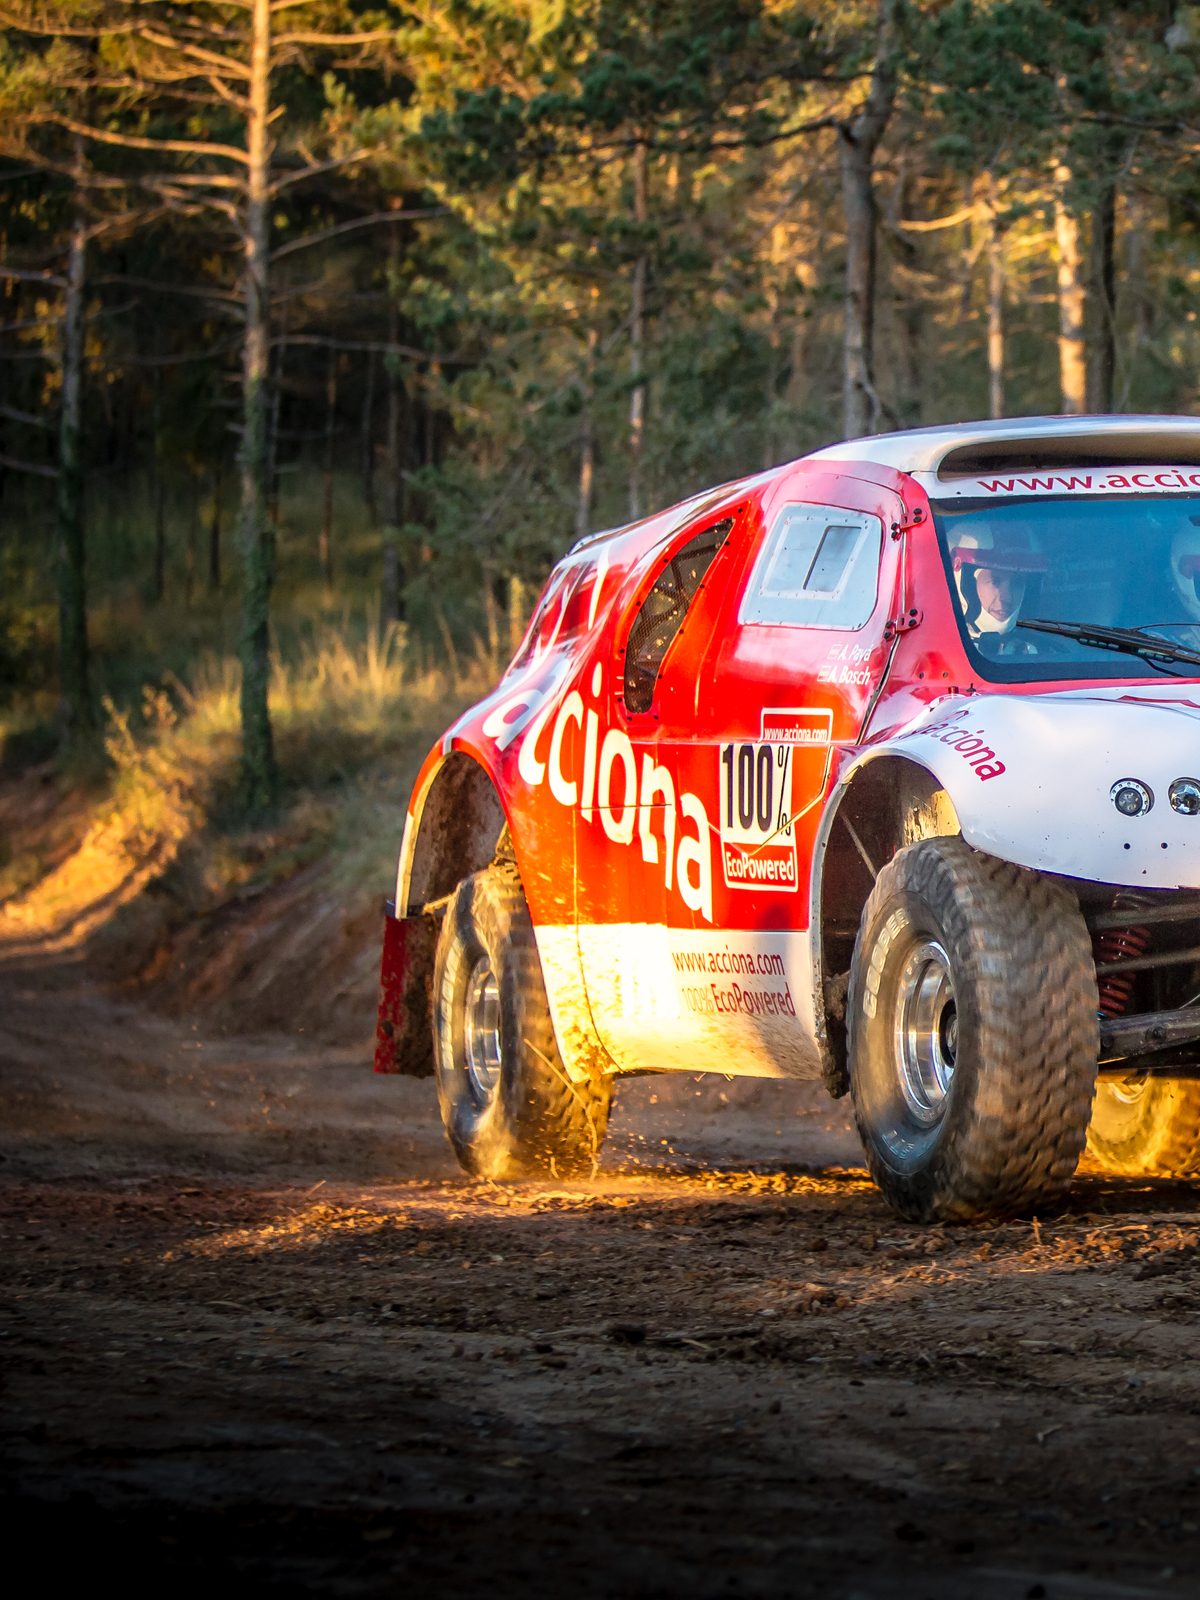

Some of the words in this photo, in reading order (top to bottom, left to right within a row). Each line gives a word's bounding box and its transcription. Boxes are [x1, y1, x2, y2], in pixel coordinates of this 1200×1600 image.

[837, 644, 847, 660] A.
[827, 665, 837, 683] A.
[838, 665, 871, 685] Bosch
[764, 723, 828, 741] www.acciona.com
[482, 656, 713, 924] acciona
[722, 743, 792, 836] 100%
[726, 851, 794, 881] EcoPowered
[672, 944, 785, 976] www.acciona.com
